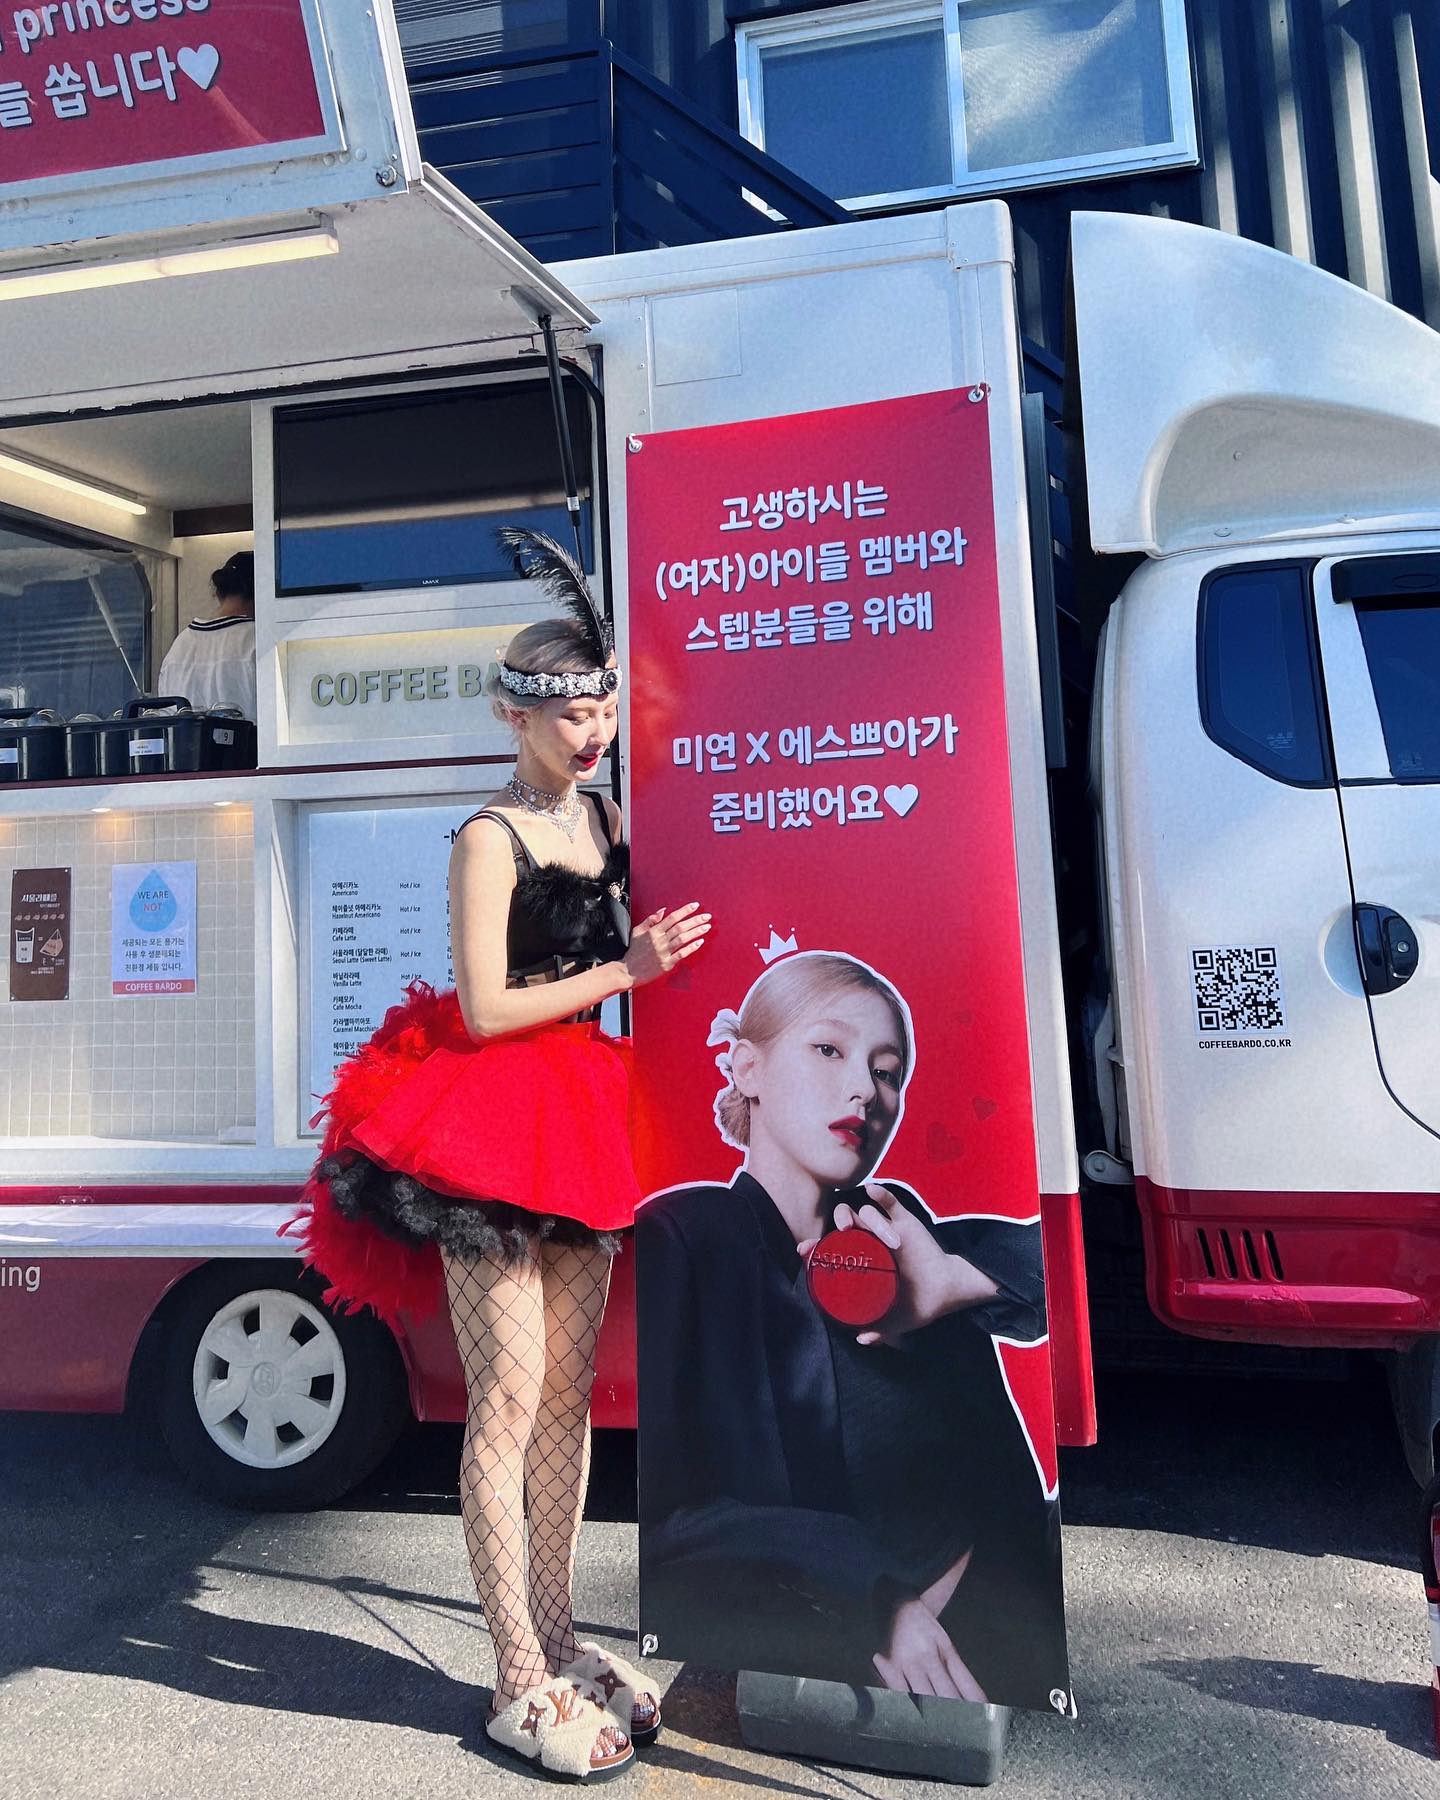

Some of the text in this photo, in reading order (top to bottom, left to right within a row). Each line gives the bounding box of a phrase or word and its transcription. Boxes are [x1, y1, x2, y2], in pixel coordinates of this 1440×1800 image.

[719, 480, 888, 531] 고생하시는
[655, 527, 968, 601] (여자)아이들 멤버와
[685, 591, 934, 651] 스텝분들을 위해
[310, 665, 448, 707] COFFEE
[672, 713, 959, 772] 미연 X 에스쁘아가
[709, 784, 885, 833] 준비했어요
[137, 890, 169, 899] WE ARE
[125, 982, 182, 991] COFFEE BARDO
[1199, 1039, 1292, 1049] COFFEEBARDO.CO.KR
